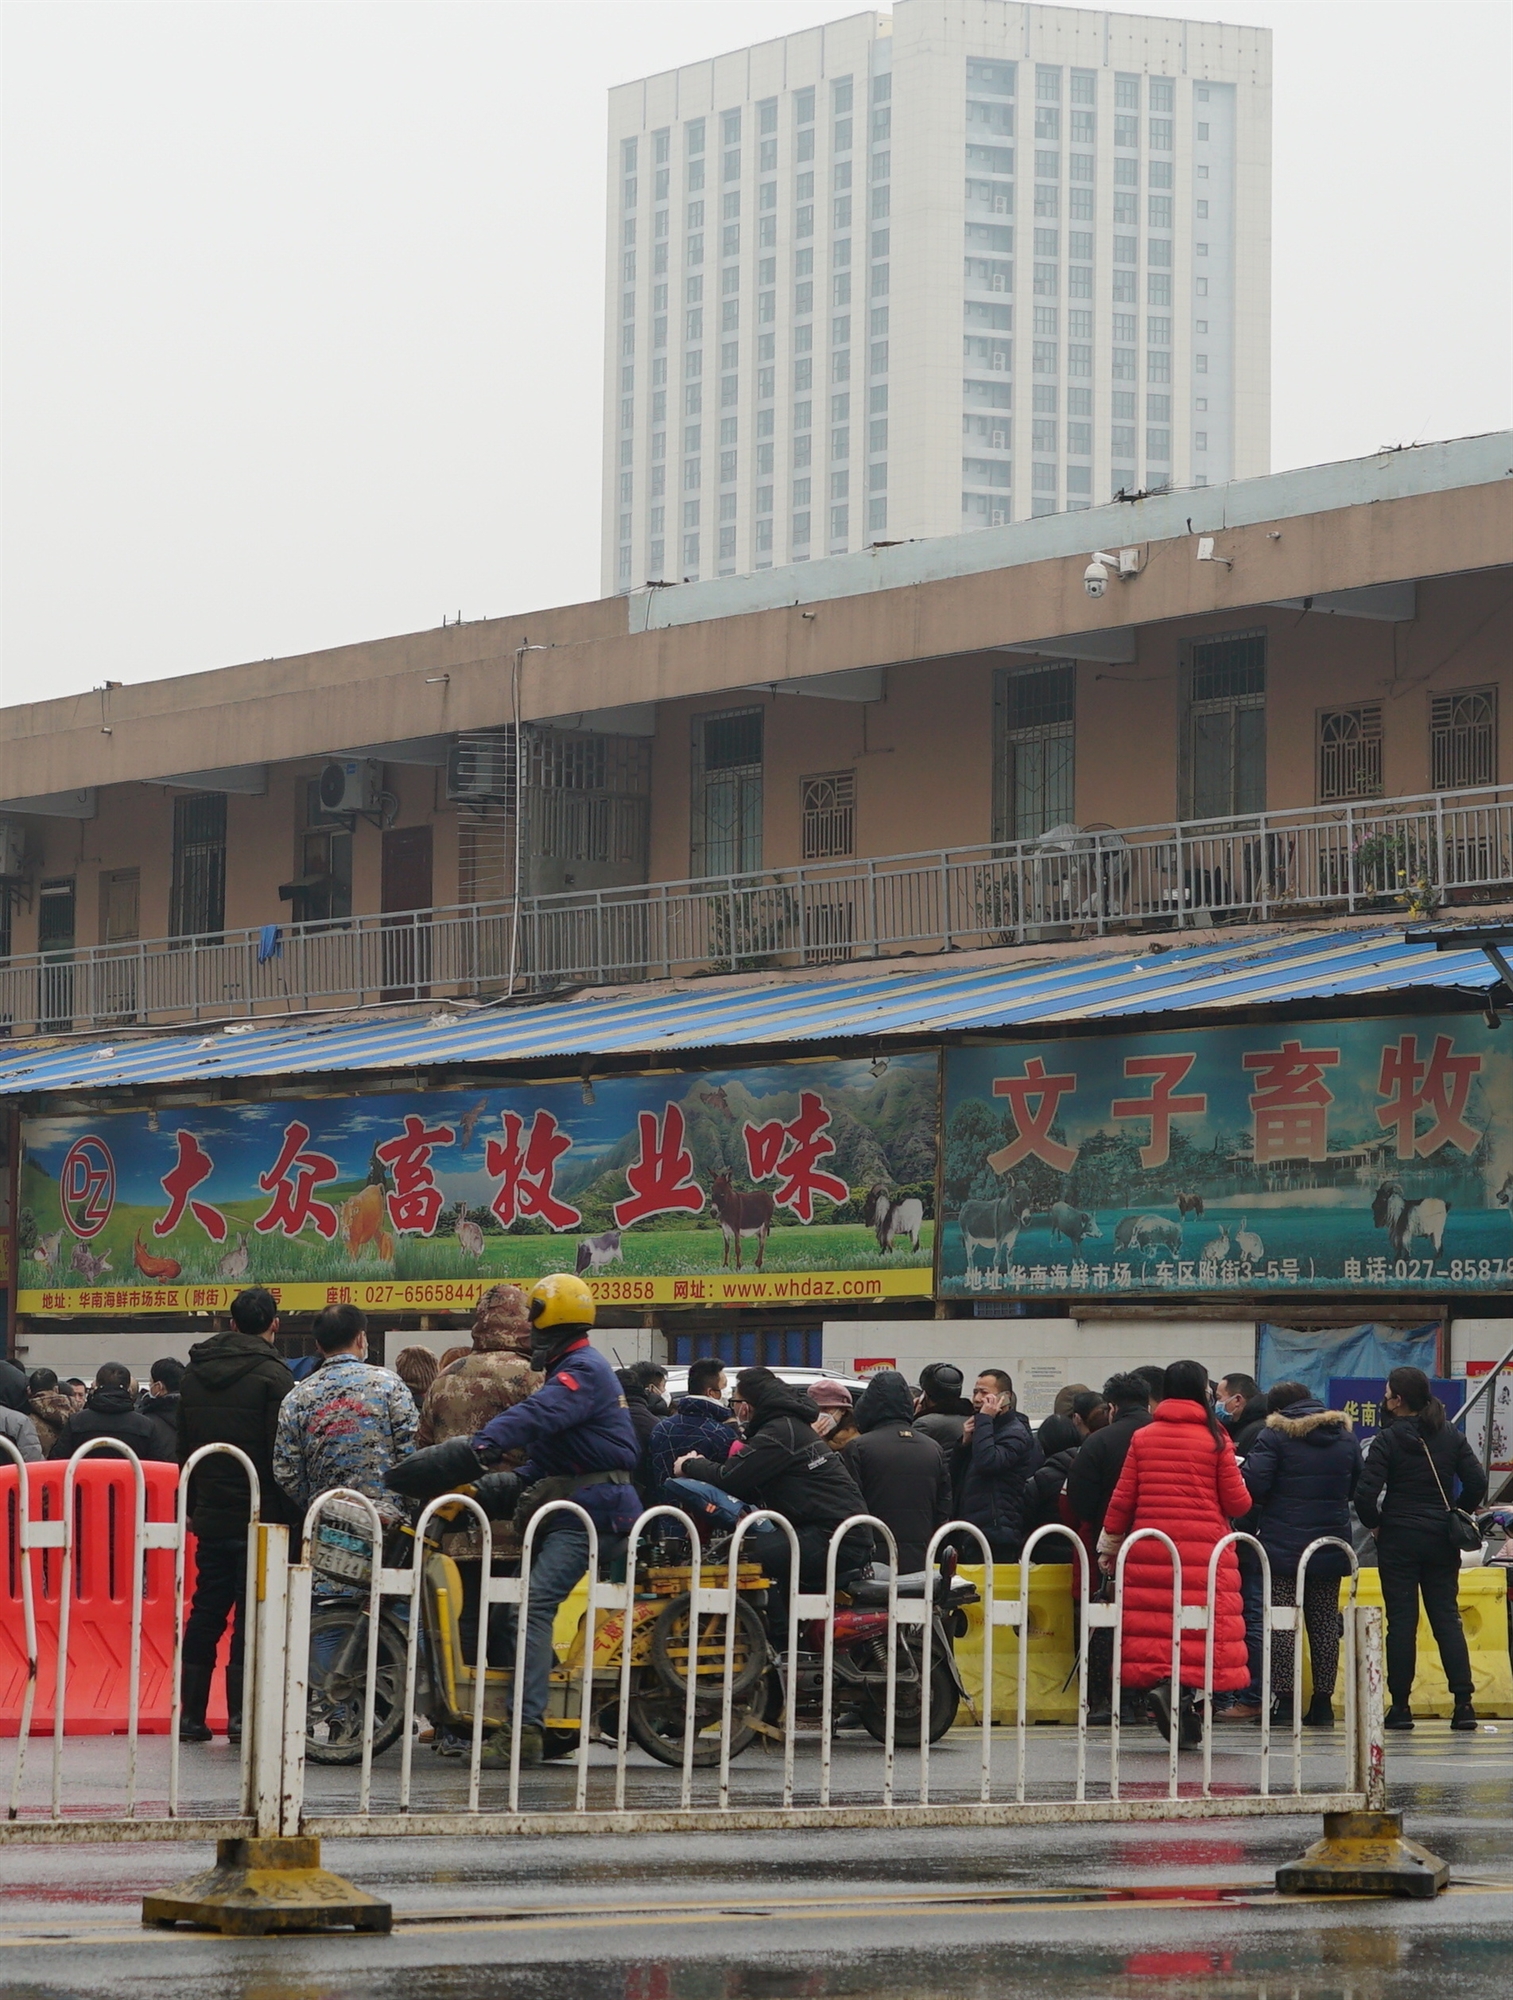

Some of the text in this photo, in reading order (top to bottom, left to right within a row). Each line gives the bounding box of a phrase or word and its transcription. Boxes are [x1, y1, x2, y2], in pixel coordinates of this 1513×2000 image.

[987, 1033, 1484, 1175] 文子畜牧
[68, 1151, 109, 1220] DZ
[153, 1089, 850, 1243] 大众畜牧业味
[42, 1287, 282, 1310] 地址：华南海鲜市场东区（附街）号
[587, 1281, 654, 1300] 233858
